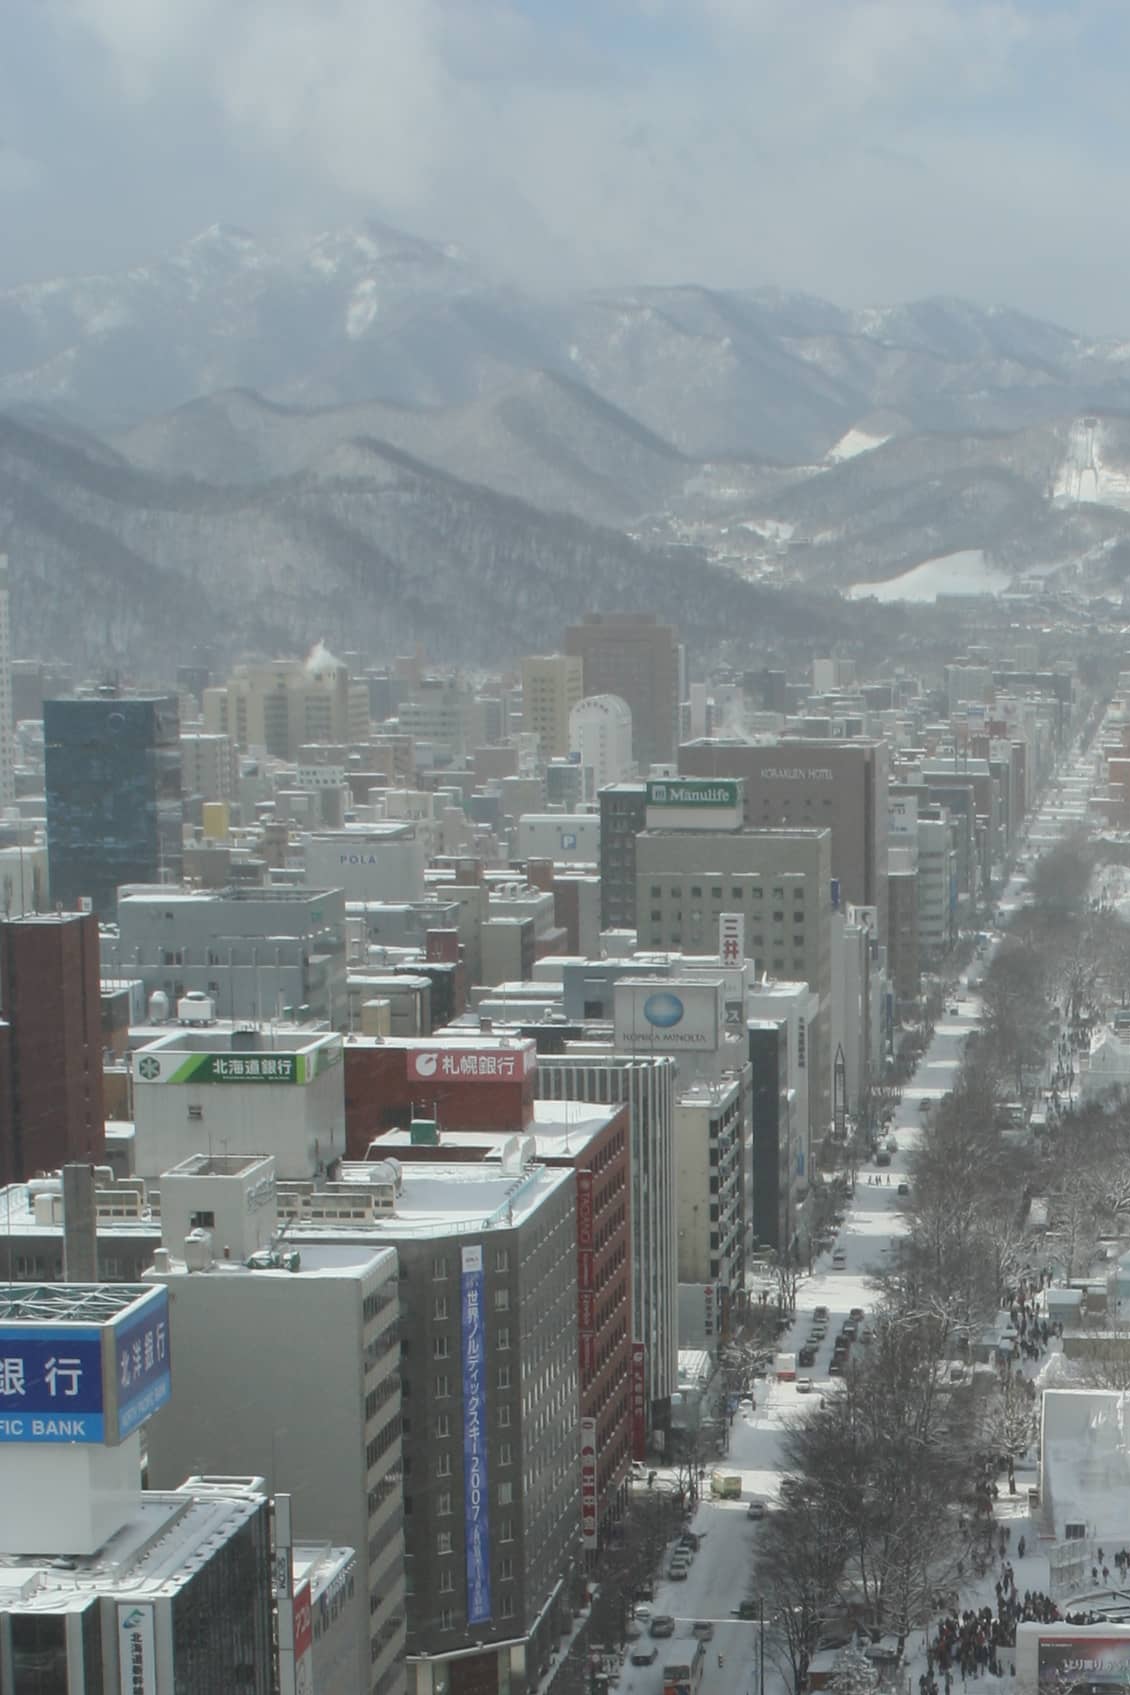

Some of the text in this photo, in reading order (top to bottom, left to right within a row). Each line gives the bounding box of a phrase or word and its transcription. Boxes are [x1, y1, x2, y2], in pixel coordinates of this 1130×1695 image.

[669, 788, 730, 802] Manulife
[339, 855, 377, 865] POLA
[723, 918, 739, 966] 三井
[212, 1058, 293, 1076] 北海道銀行
[441, 1055, 516, 1076] 札幌銀行
[32, 1419, 86, 1437] BANK
